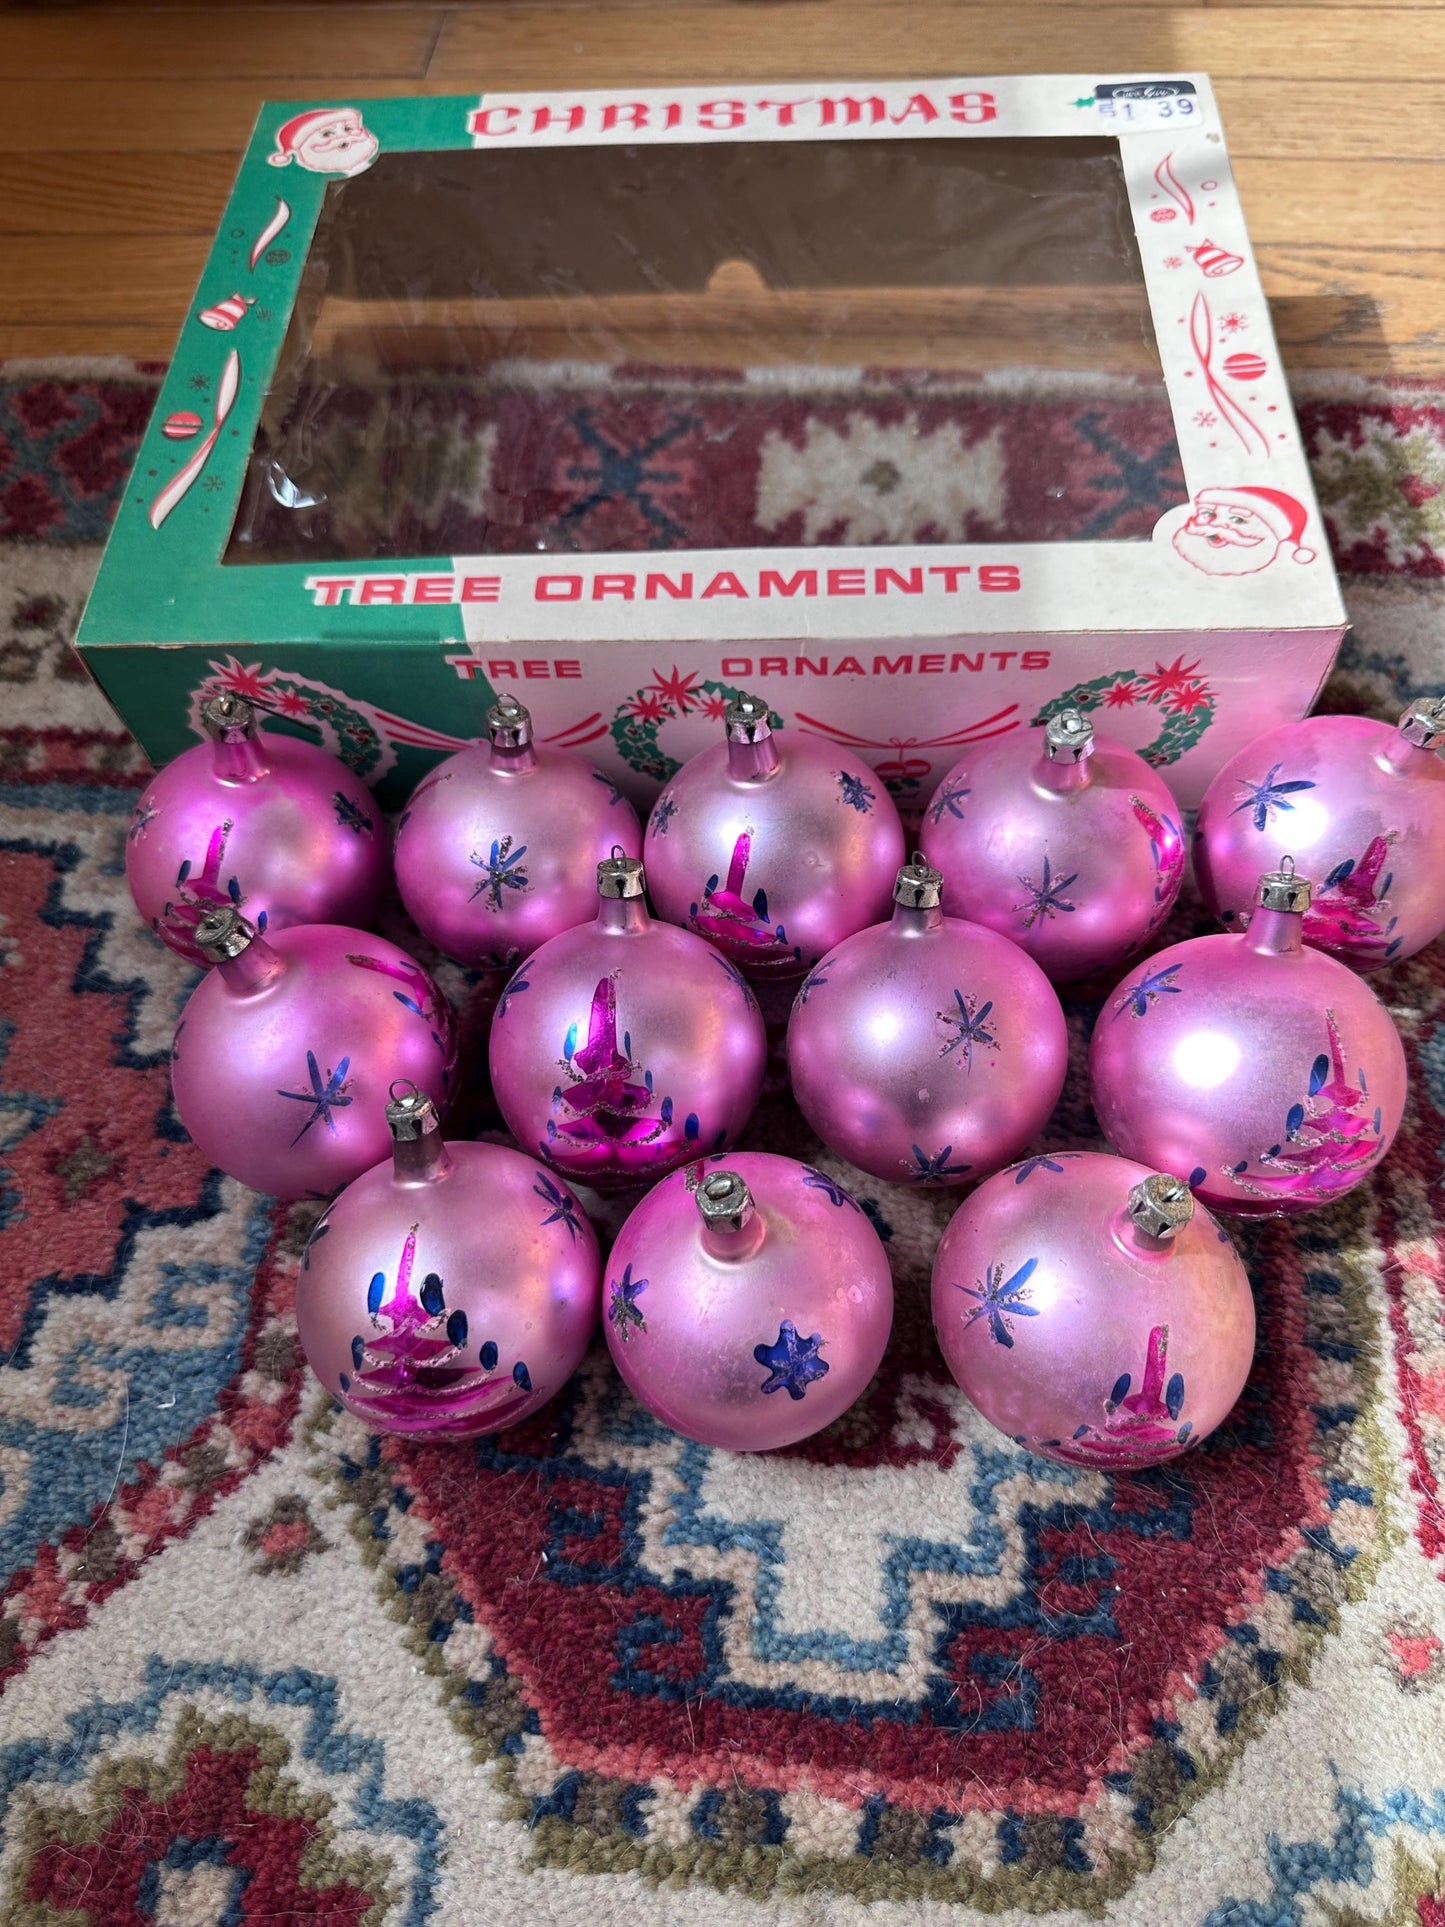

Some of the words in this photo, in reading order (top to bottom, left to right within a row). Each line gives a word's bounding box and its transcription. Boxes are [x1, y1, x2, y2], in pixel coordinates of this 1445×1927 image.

[471, 92, 998, 136] CHRISTMAS
[1158, 99, 1194, 118] 39
[314, 576, 502, 604] TREE
[534, 565, 1022, 602] ORNAMENTS
[453, 660, 583, 680] TREE
[720, 650, 1052, 677] ORNAMENTS
